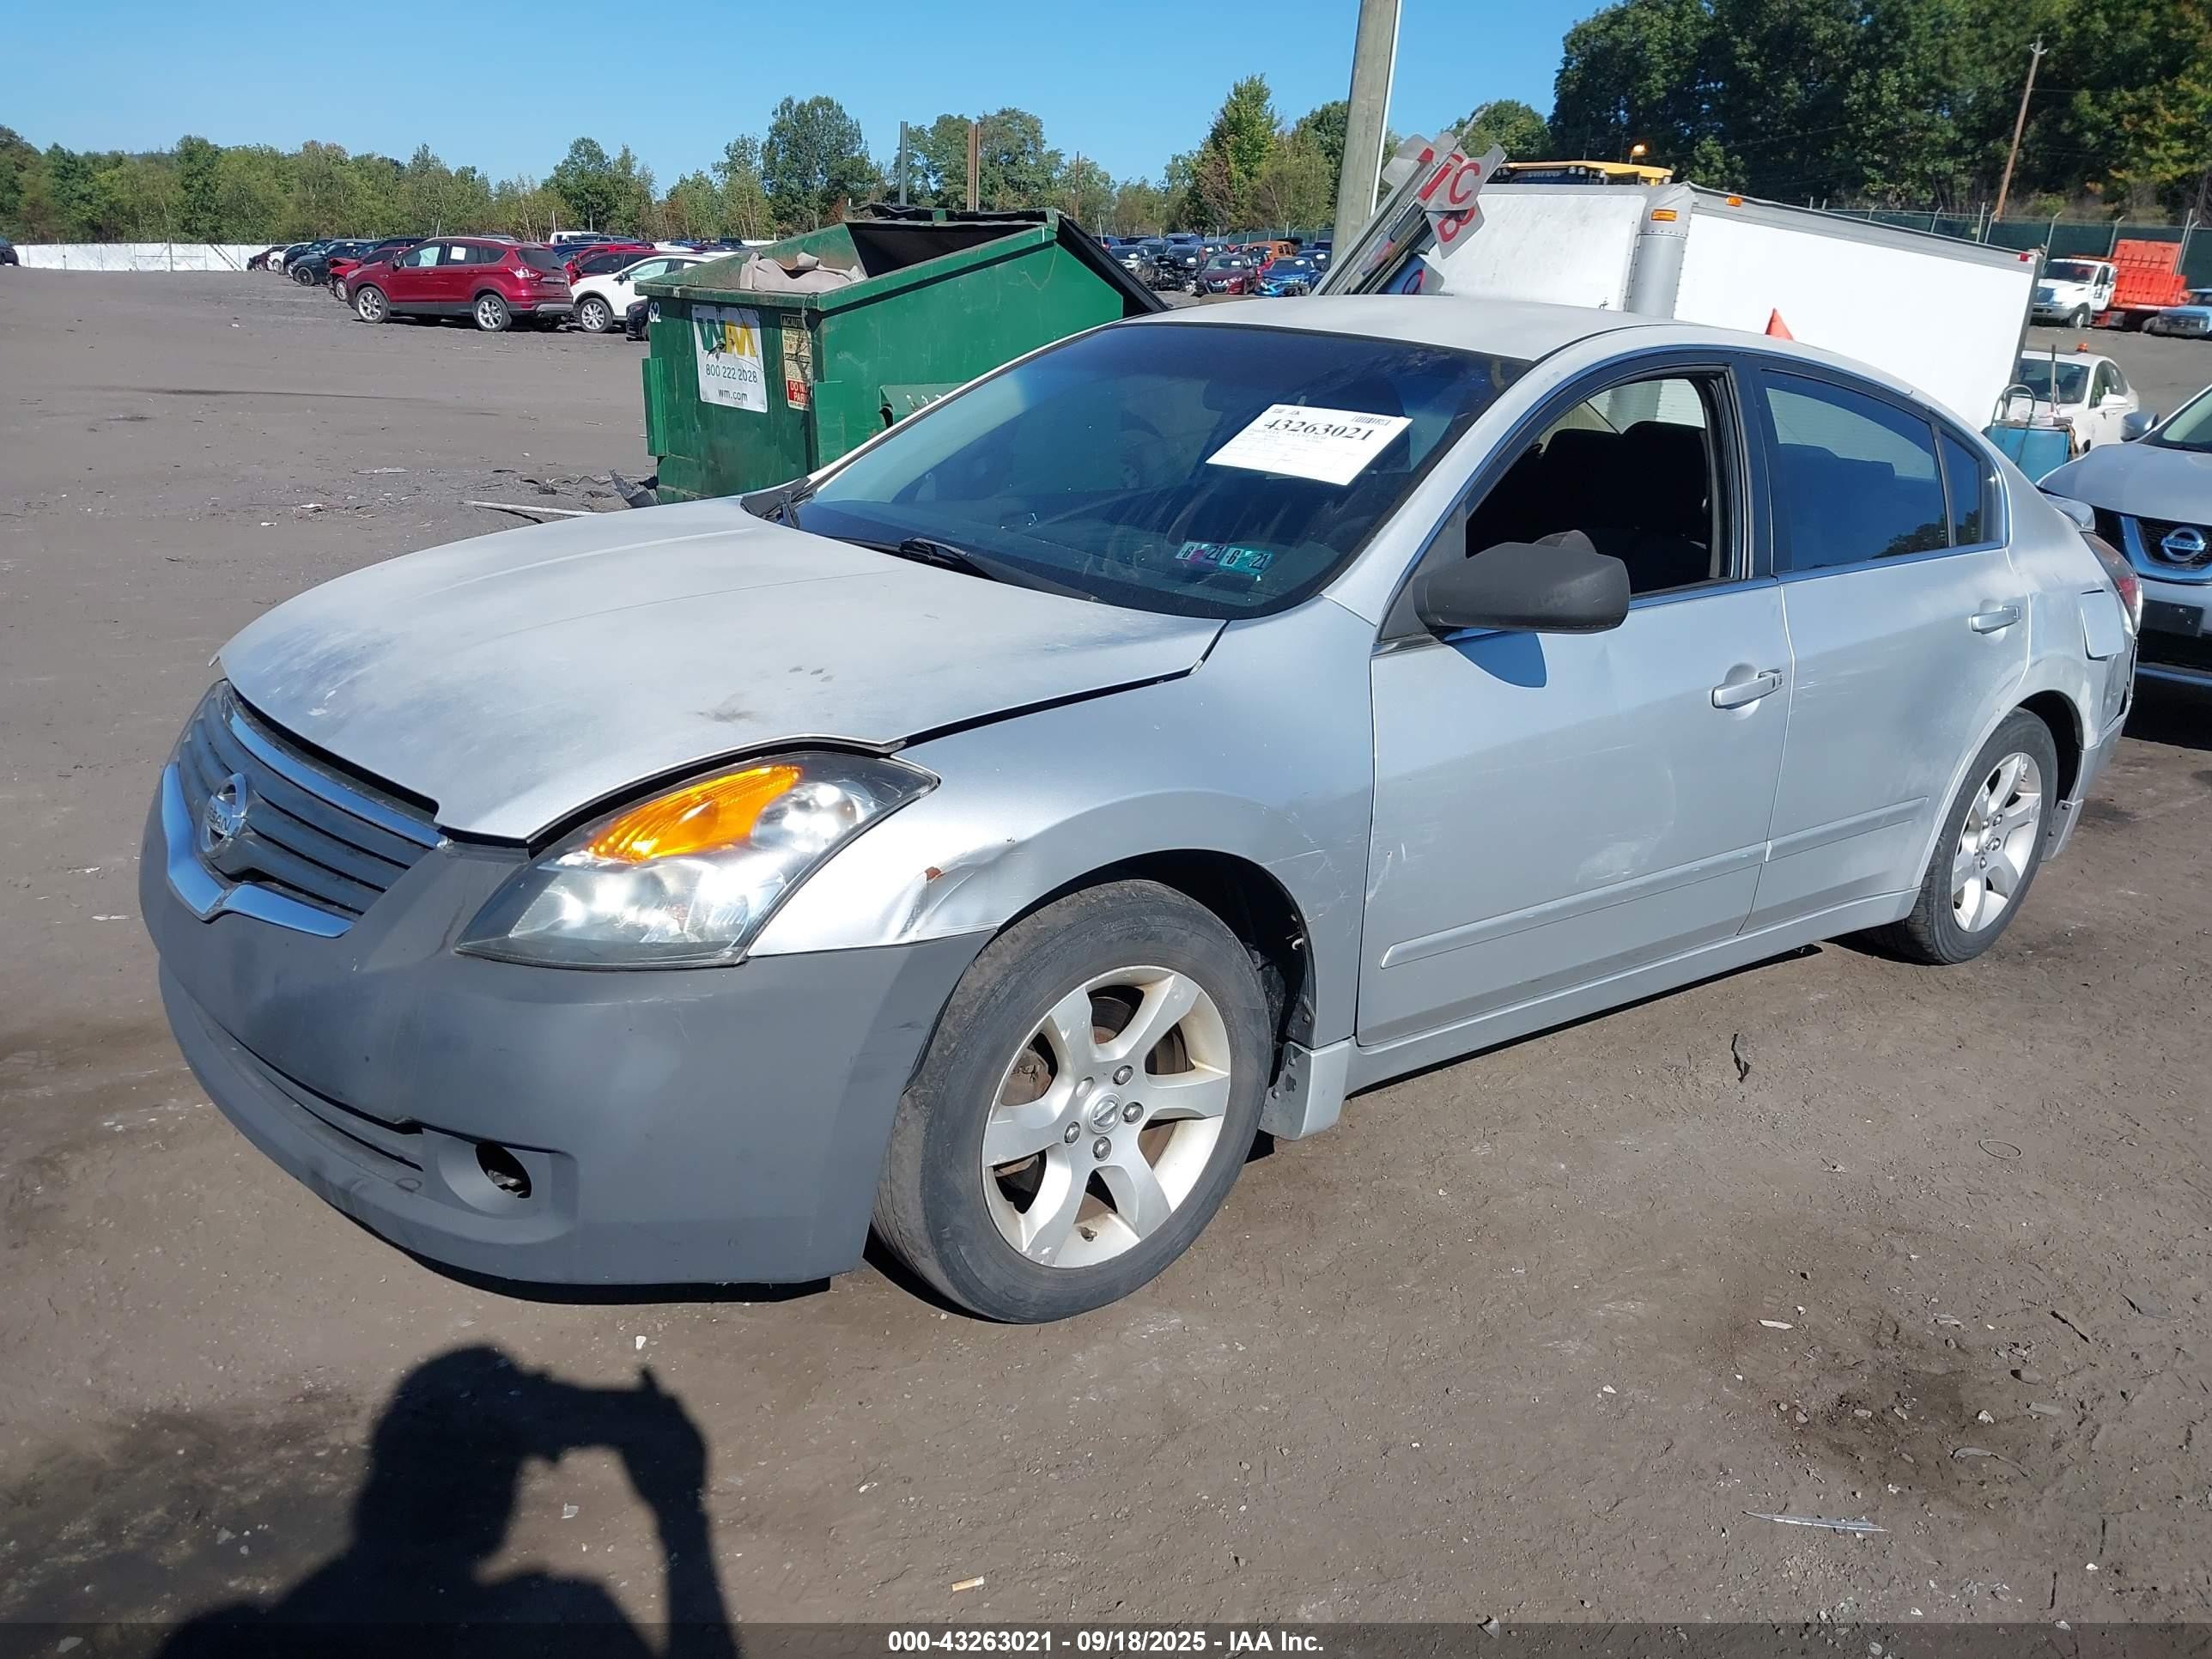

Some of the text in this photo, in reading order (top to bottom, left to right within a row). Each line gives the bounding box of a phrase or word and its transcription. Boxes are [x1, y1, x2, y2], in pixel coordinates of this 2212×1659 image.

[648, 301, 662, 324] 62
[696, 316, 759, 358] WM
[705, 363, 759, 384] 800 222 2028
[717, 387, 748, 402] wm.com
[789, 381, 799, 392] DO
[1264, 417, 1374, 441] 43263021
